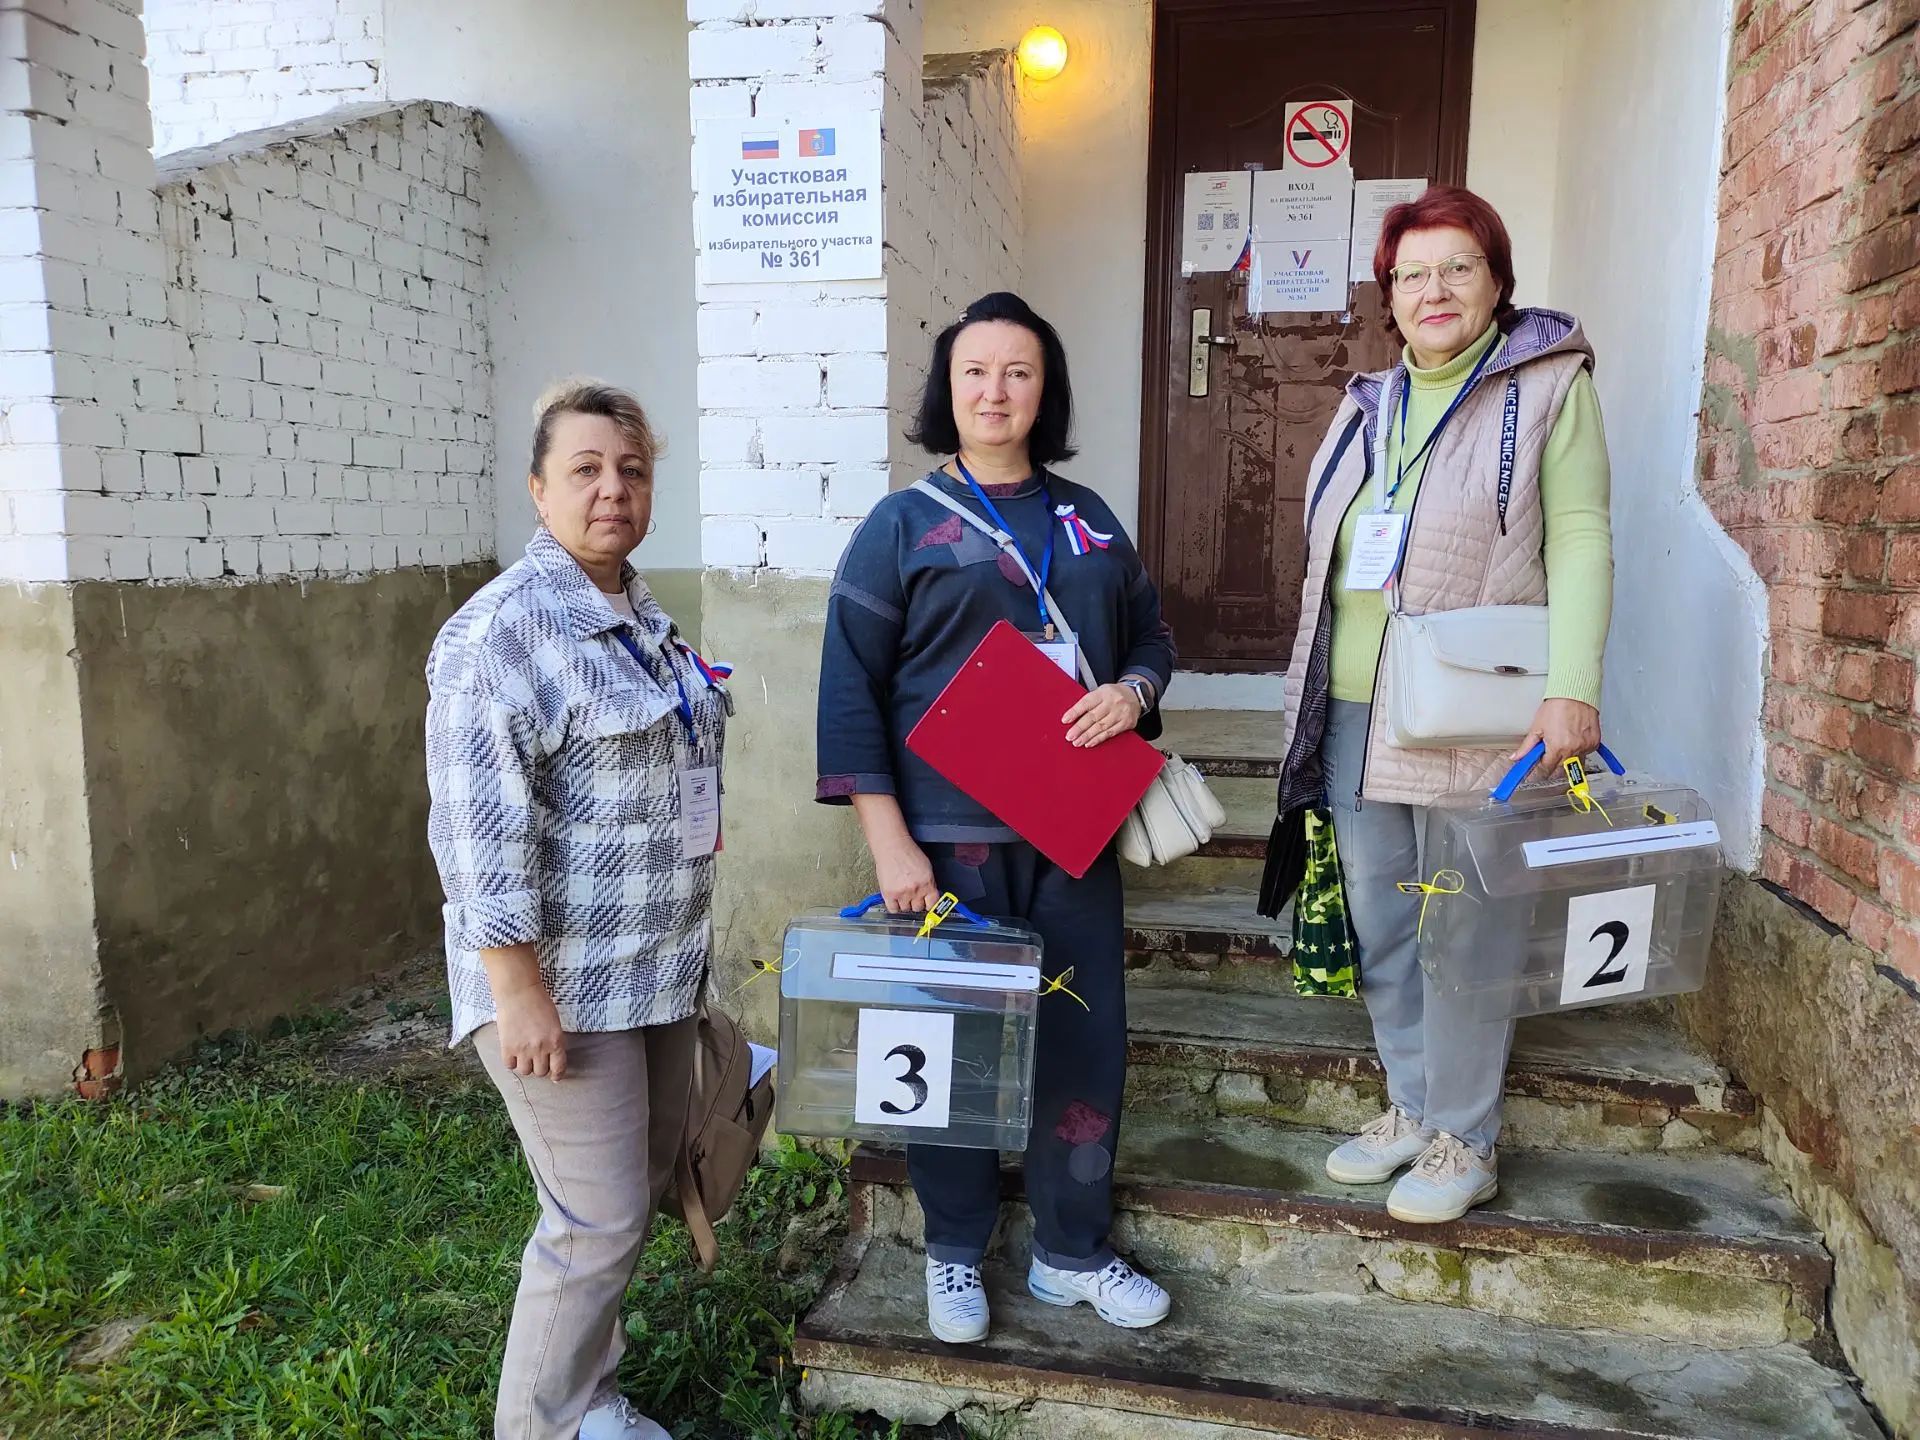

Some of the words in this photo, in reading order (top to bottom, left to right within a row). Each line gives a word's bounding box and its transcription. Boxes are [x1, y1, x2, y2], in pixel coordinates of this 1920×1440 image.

[731, 168, 847, 186] Участковая
[1288, 183, 1315, 191] ВХОД
[713, 188, 867, 209] избирательная
[742, 210, 838, 227] комиссия
[1286, 213, 1297, 222] №
[1298, 213, 1312, 221] 361
[708, 237, 818, 252] избирательного
[821, 235, 873, 250] участка
[761, 251, 783, 269] №
[789, 250, 820, 268] 361
[1266, 278, 1330, 286] ИЗБИРАТЕЛЬНАЯ
[1582, 920, 1630, 988] 2
[879, 1044, 928, 1114] 3
